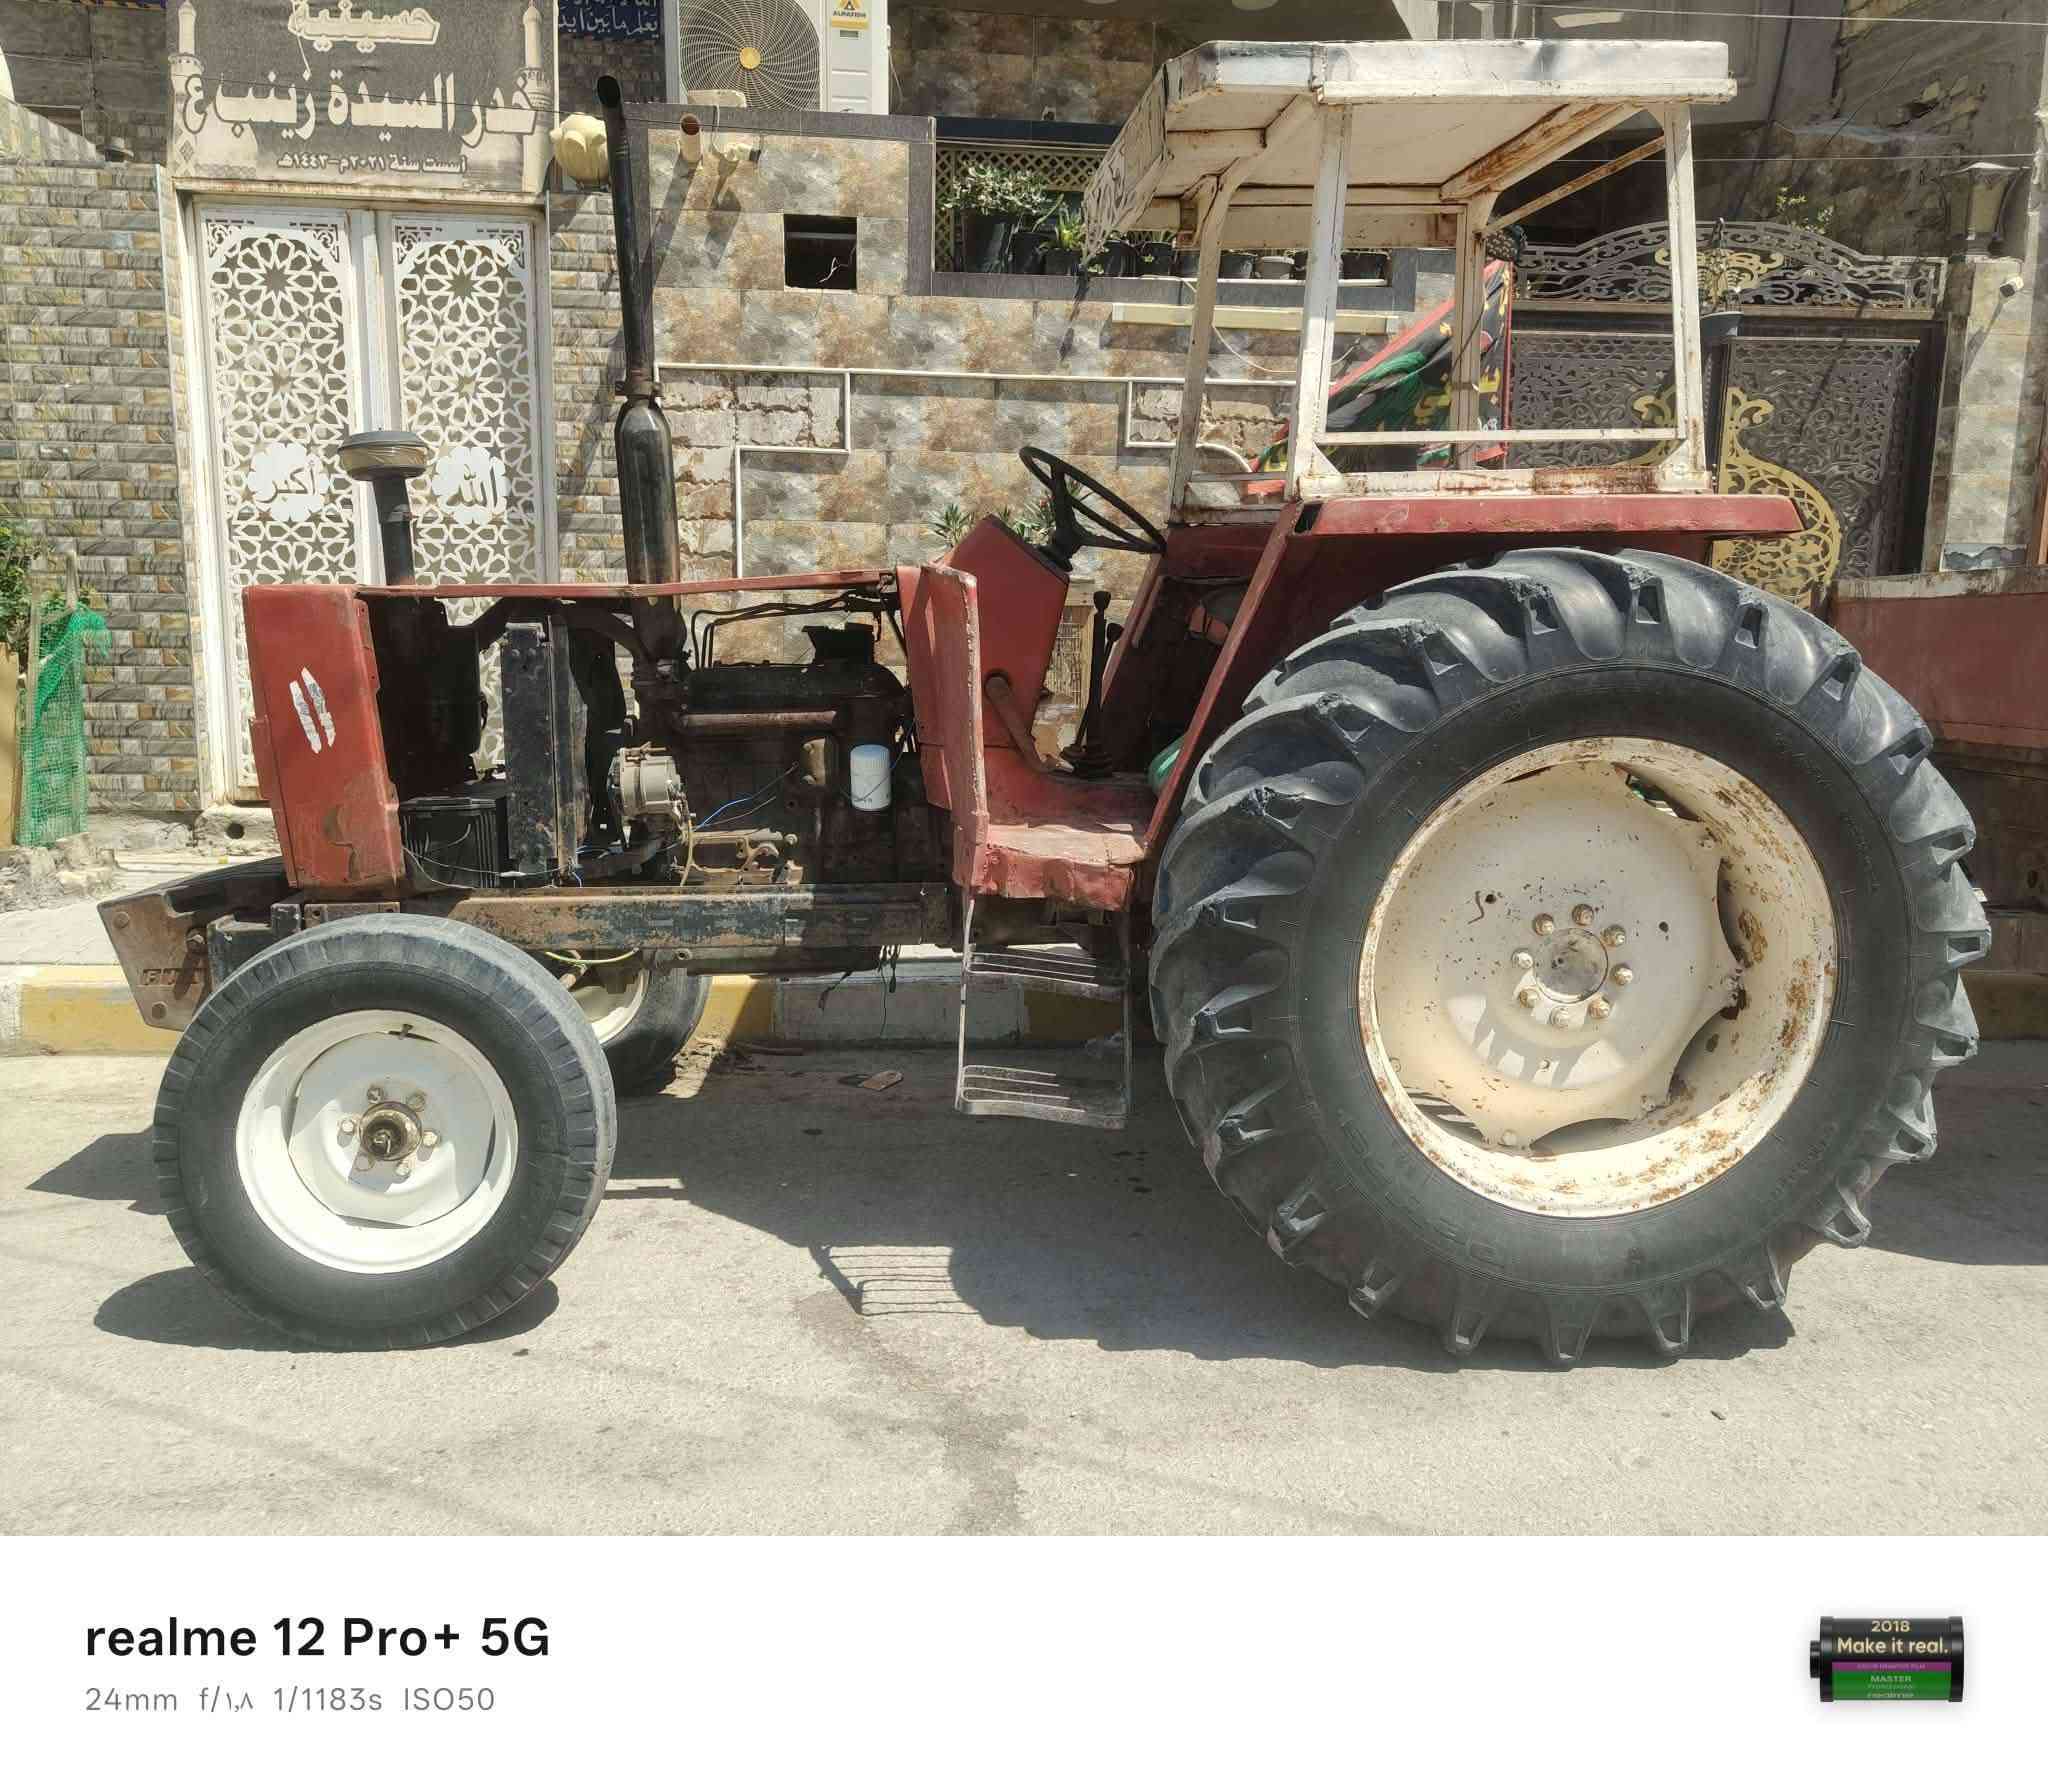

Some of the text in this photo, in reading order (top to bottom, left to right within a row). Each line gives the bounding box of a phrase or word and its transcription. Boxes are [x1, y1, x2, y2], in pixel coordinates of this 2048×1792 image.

[288, 0, 440, 53] حسينية
[214, 68, 316, 141] زينب
[327, 69, 456, 143] السيدة
[461, 74, 537, 148] خدر
[389, 153, 420, 173] سنة
[446, 463, 499, 508] الله
